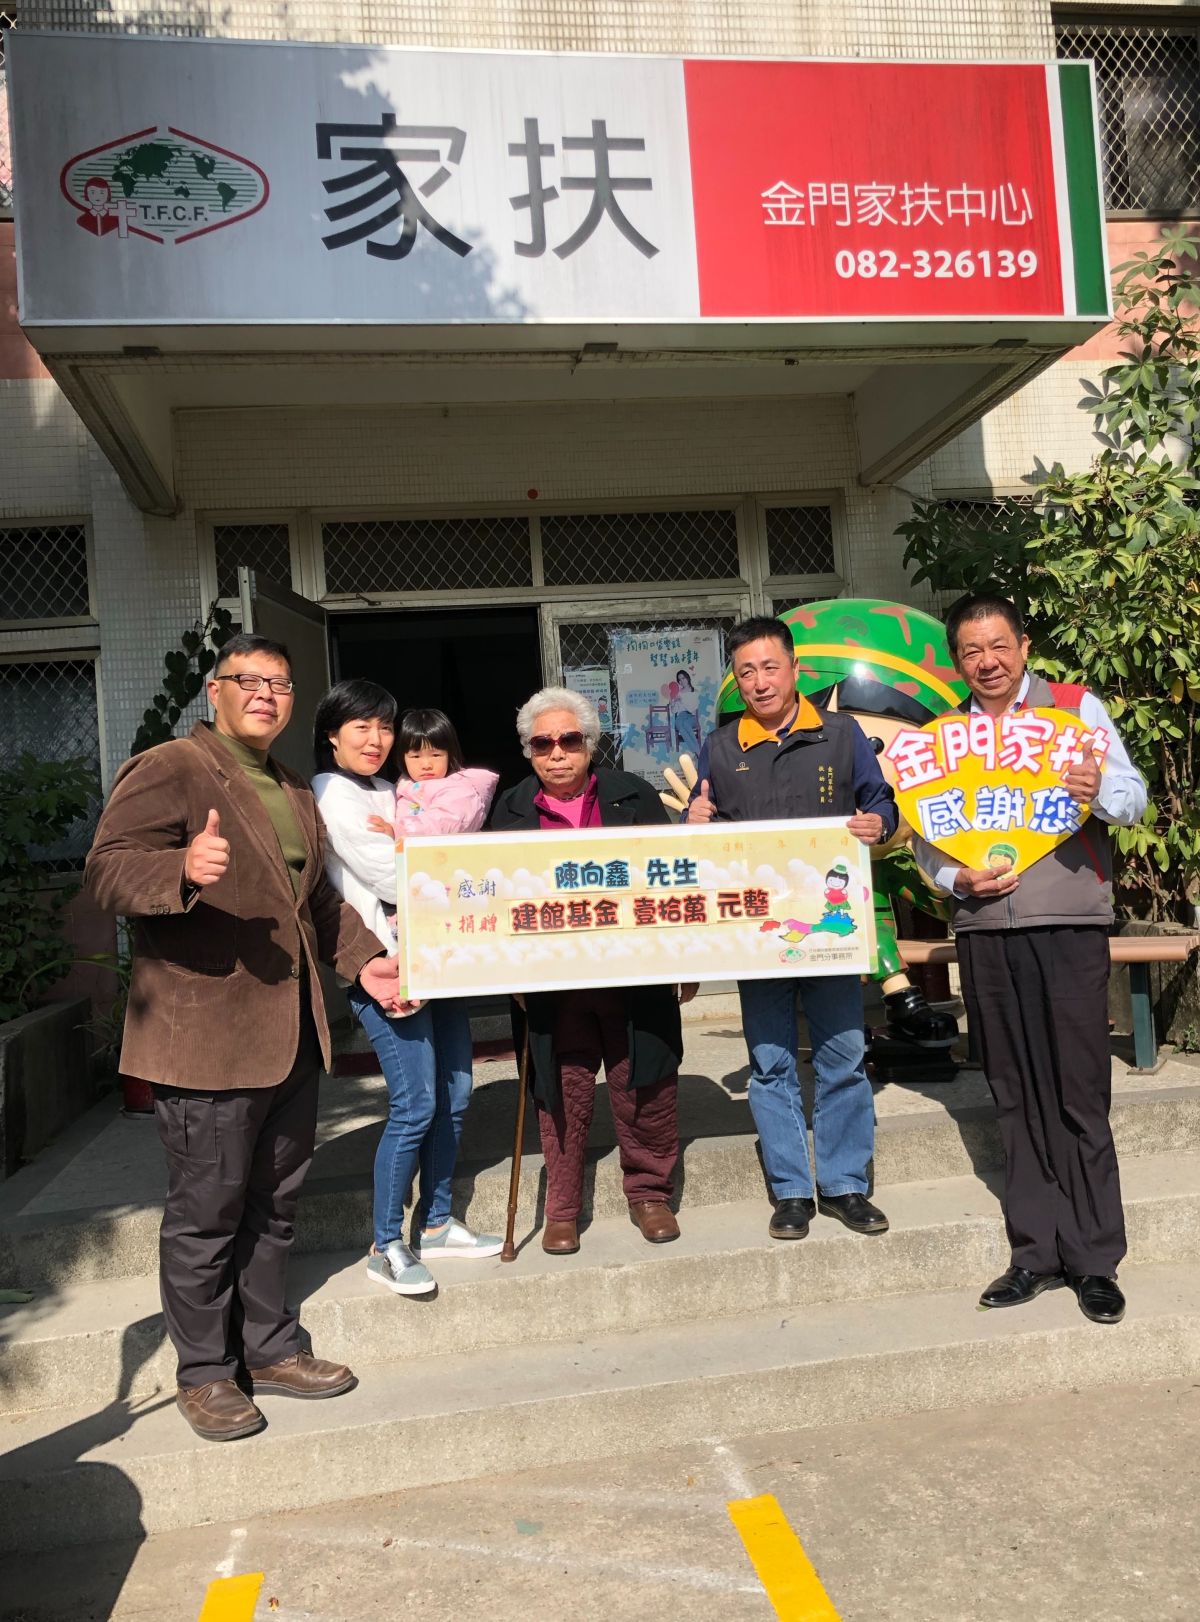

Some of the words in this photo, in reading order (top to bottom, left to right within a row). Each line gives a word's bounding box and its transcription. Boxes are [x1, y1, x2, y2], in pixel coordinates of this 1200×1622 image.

[315, 112, 660, 261] 家扶
[761, 180, 1034, 228] 金門家扶中心
[139, 203, 210, 224] T.F.C.F.
[835, 249, 1038, 280] 082-326139
[918, 785, 1082, 842] 感謝您
[457, 878, 496, 899] 感謝
[554, 858, 630, 889] 陳向鑫
[645, 857, 699, 887] 先生
[458, 913, 498, 934] 捐贈
[510, 898, 620, 932] 建館基金
[633, 894, 708, 927] 壹拾萬
[716, 888, 771, 921] 元整
